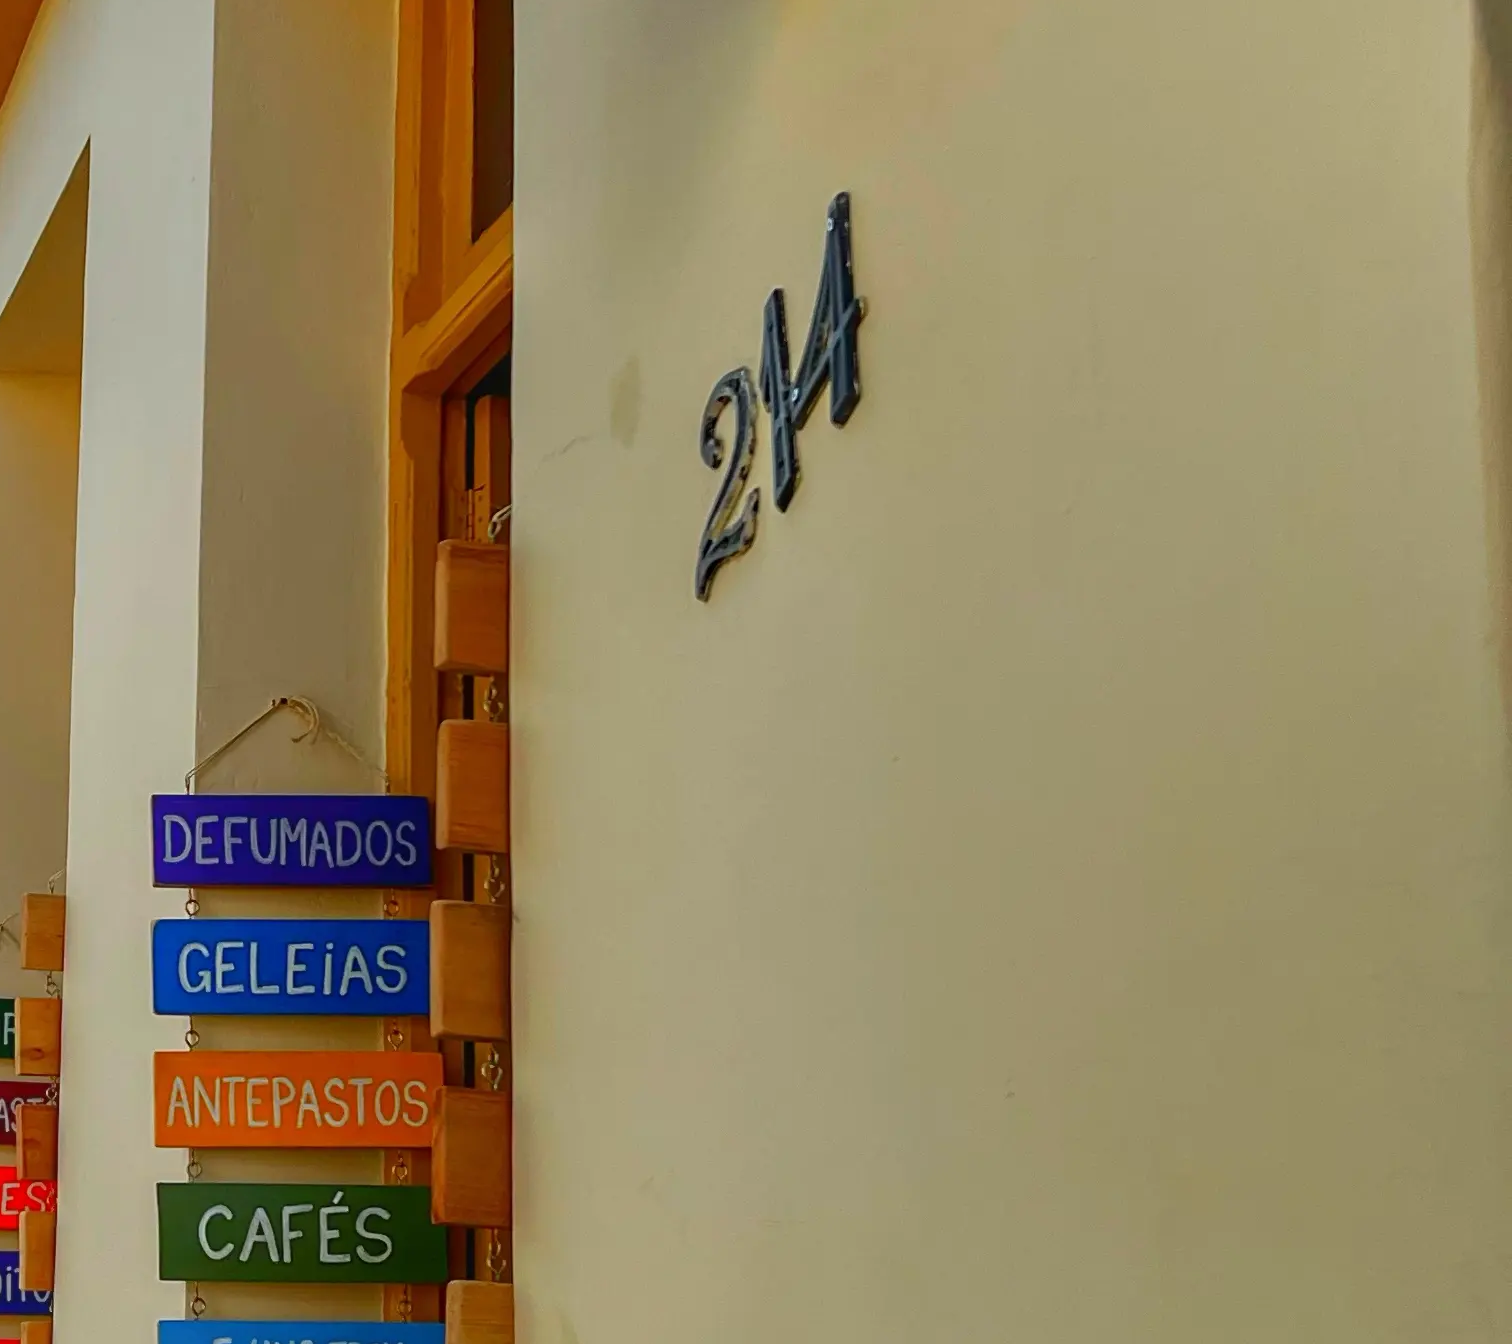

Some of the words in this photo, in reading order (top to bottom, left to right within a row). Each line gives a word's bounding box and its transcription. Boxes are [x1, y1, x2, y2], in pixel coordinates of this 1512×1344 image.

[162, 814, 418, 867] DEFUMADOS
[166, 1074, 430, 1128] ANTEPASTOS
[198, 1191, 394, 1265] CAFÉS
